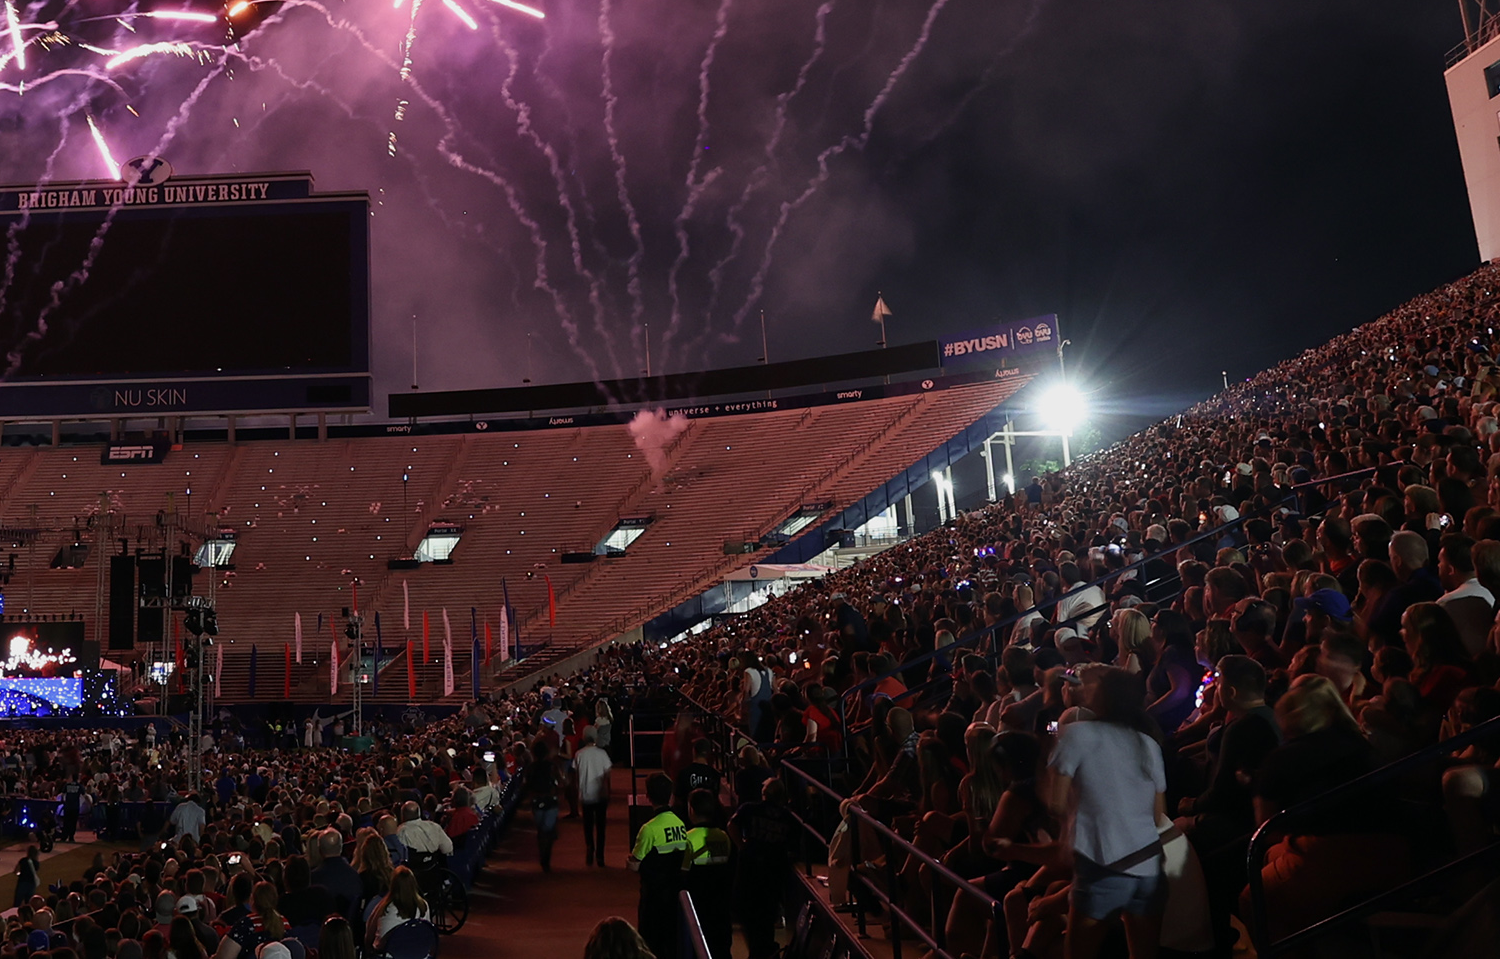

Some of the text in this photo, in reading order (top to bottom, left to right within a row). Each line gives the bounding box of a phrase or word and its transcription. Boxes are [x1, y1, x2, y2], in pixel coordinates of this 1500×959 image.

[17, 182, 270, 209] BRIGHAM YOUNG UNIVERSITY
[943, 333, 1009, 358] #BYUSN
[114, 388, 187, 407] NU SKIN
[836, 390, 863, 400] smarty
[668, 405, 710, 417] universe
[724, 399, 778, 413] everything
[386, 424, 412, 433] smarty
[108, 445, 154, 460] ESPN
[664, 826, 688, 843] EMS
